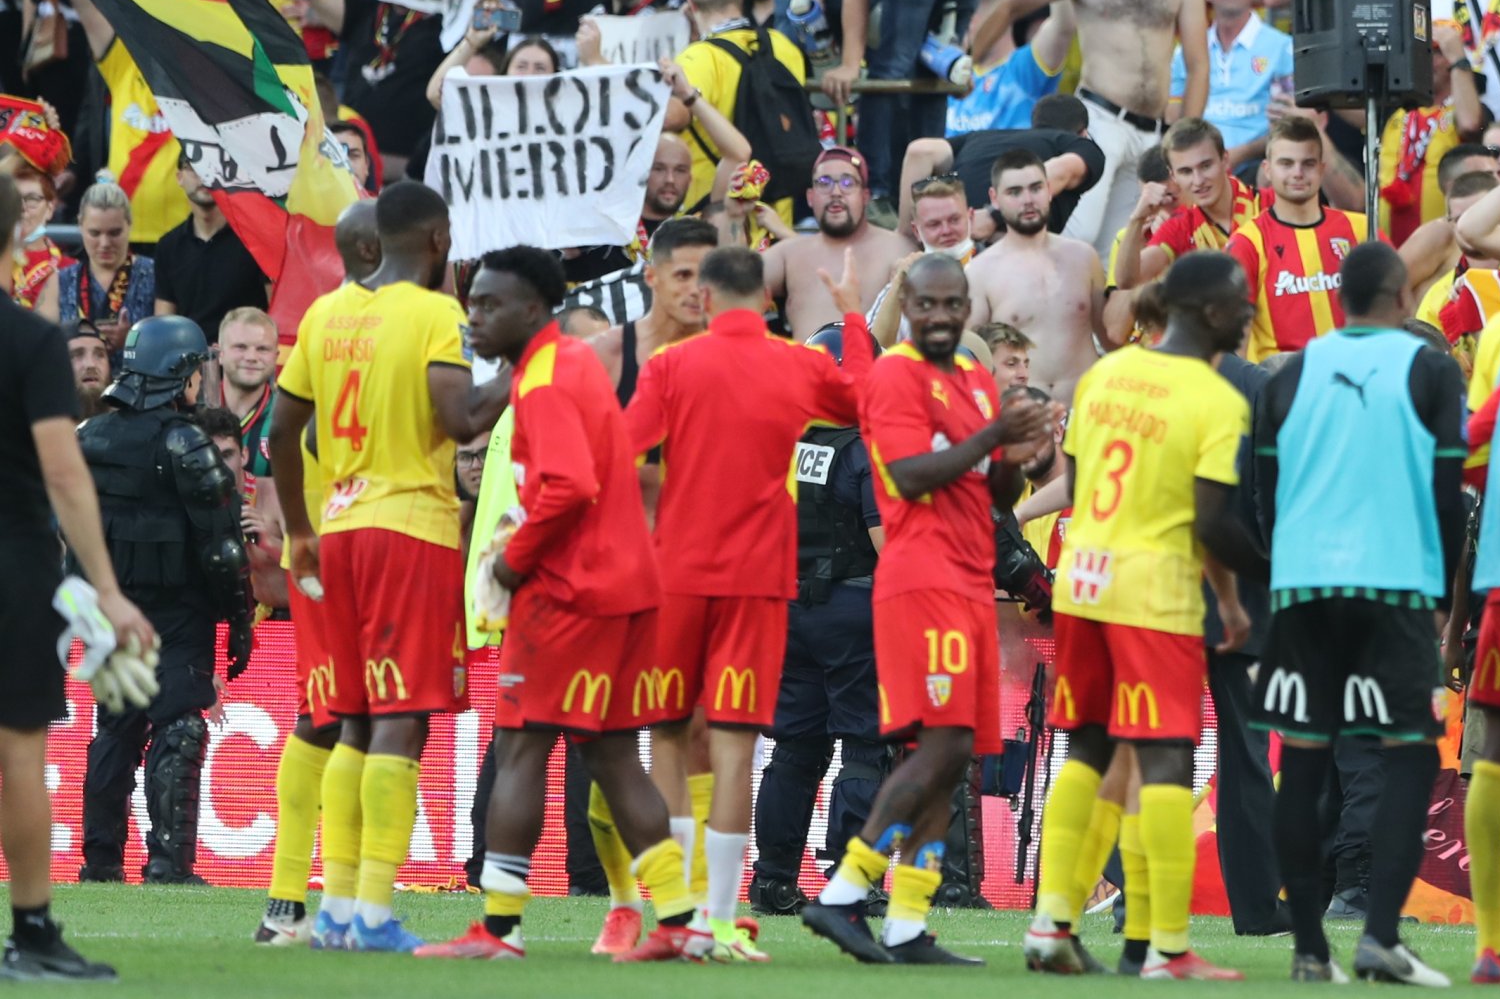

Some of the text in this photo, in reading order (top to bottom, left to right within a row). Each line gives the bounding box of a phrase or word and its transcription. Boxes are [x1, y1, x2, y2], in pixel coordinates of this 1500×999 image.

[332, 369, 369, 453] 4
[1090, 440, 1134, 522] 3
[923, 629, 969, 674] 10
